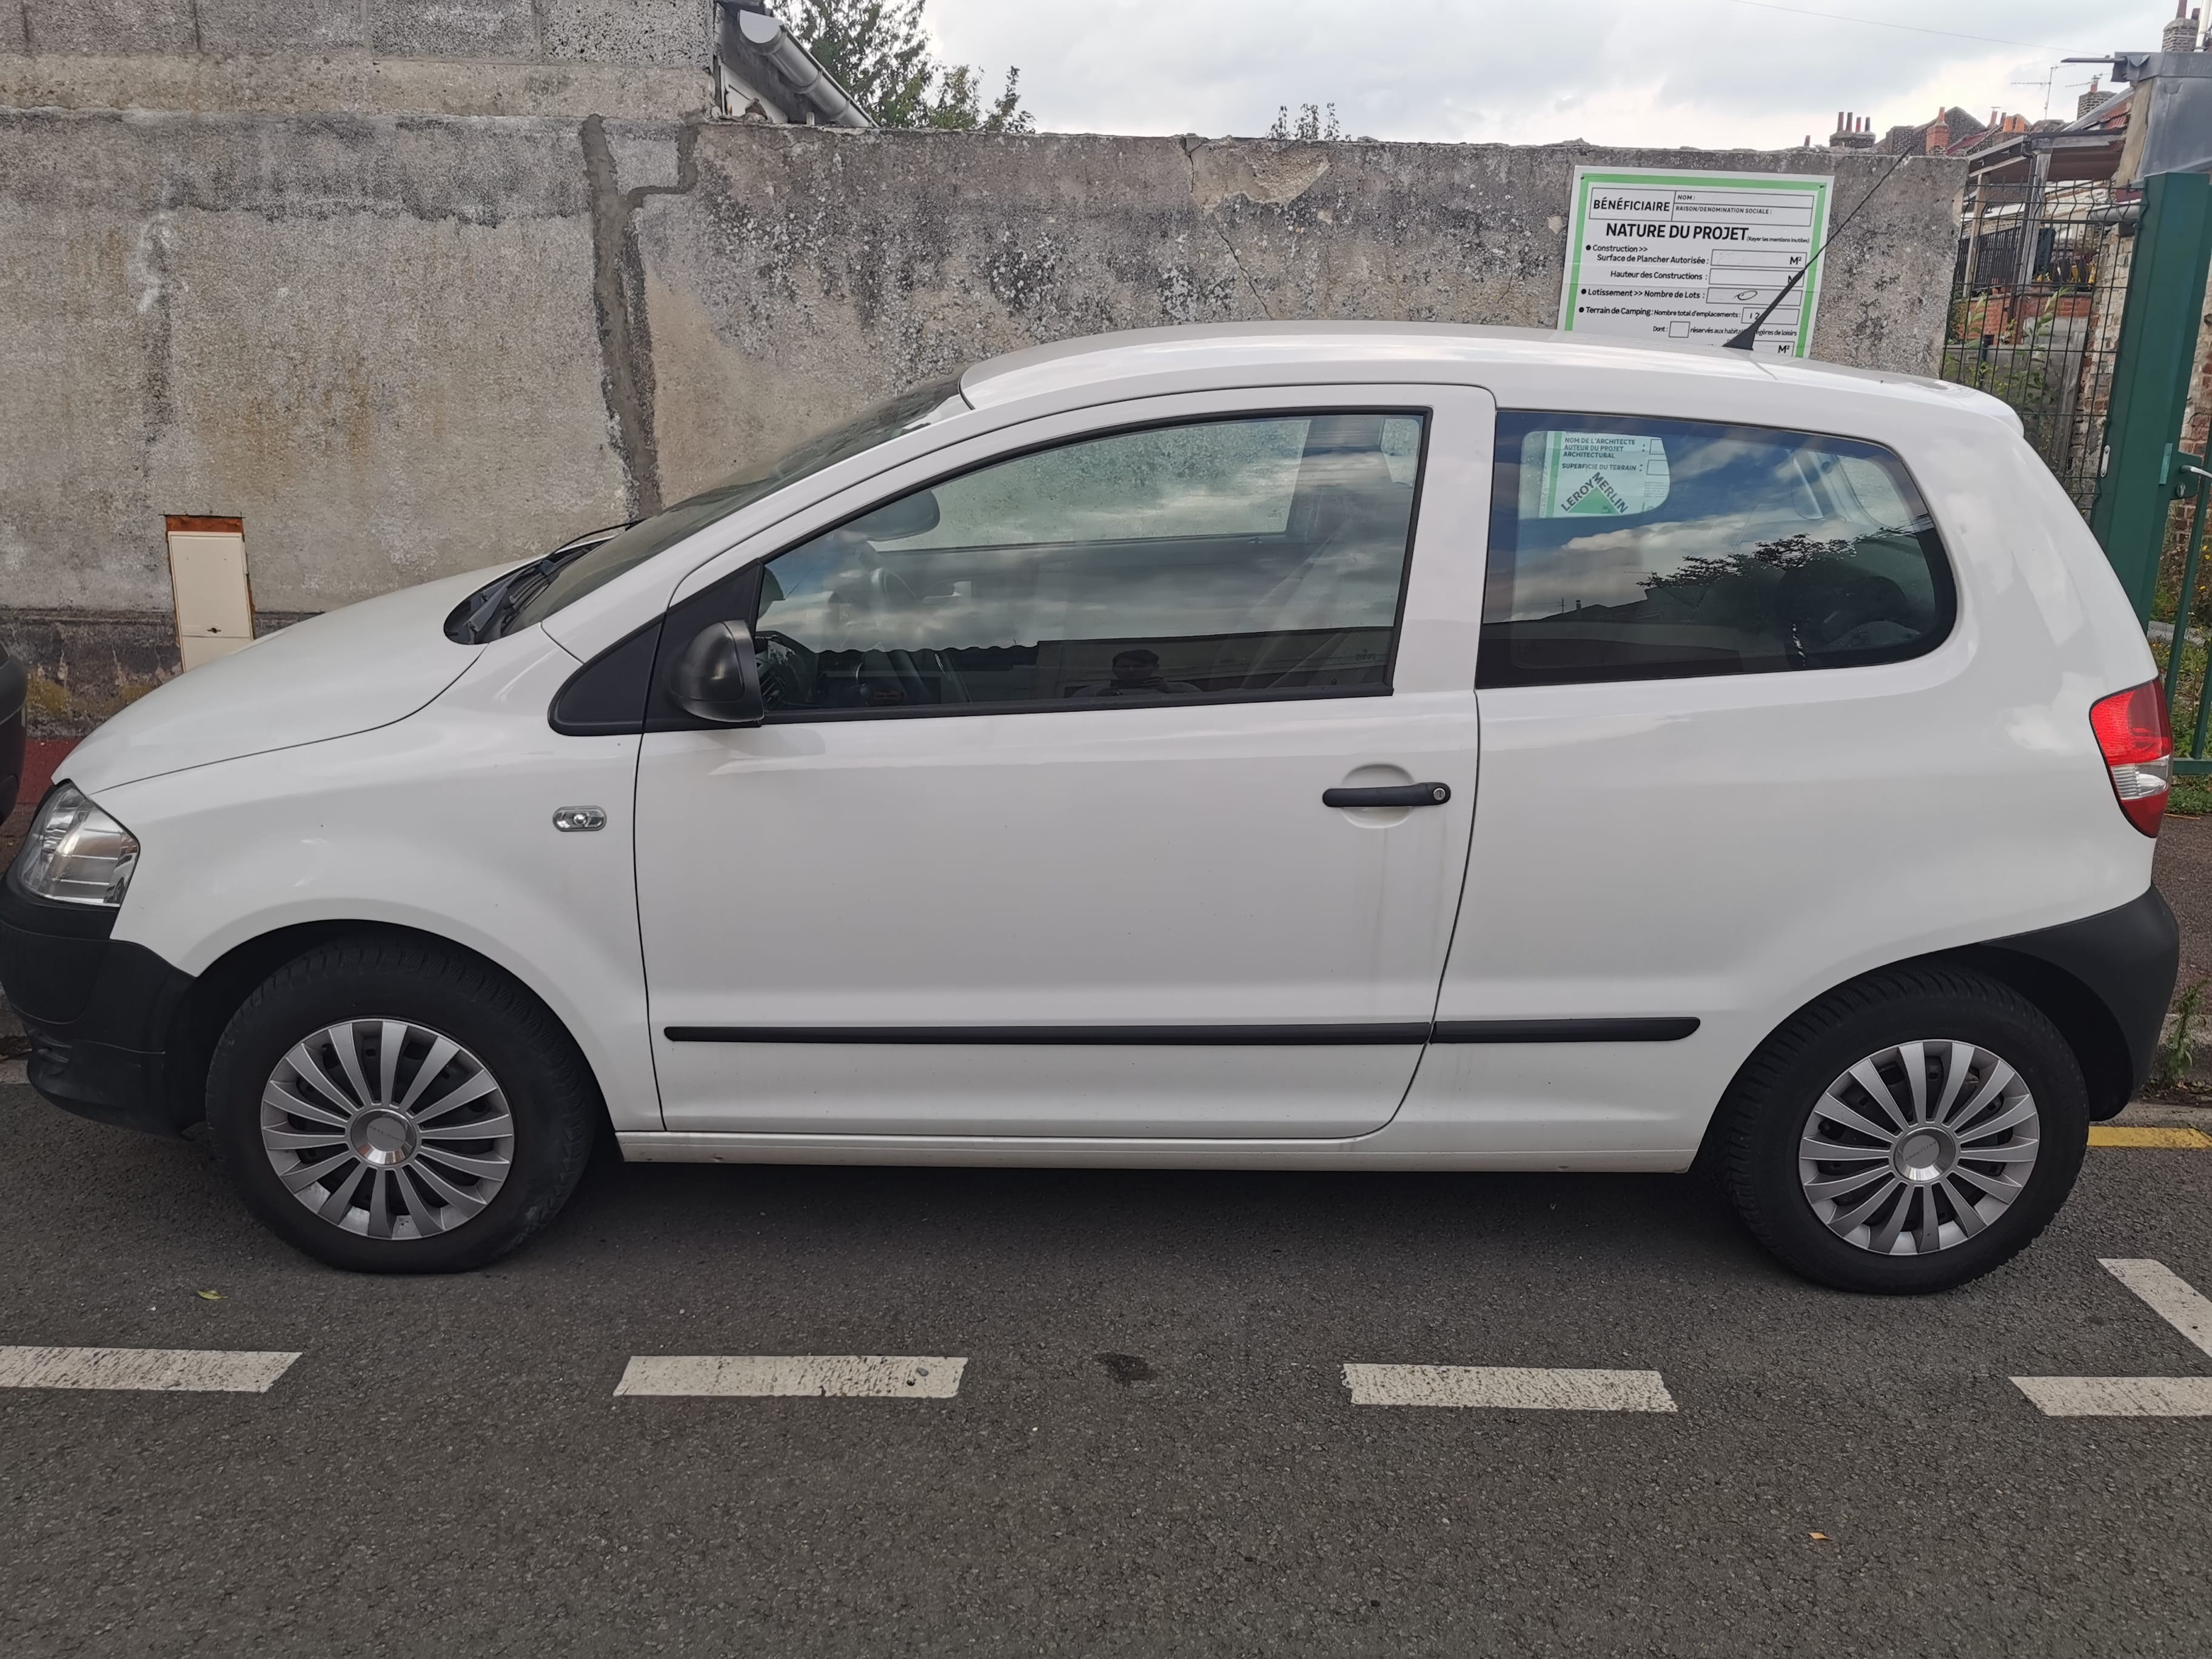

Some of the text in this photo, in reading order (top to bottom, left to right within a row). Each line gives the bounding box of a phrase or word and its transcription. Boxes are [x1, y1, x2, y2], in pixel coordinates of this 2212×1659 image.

[1593, 197, 1671, 212] BÉNÉFICIAIRE
[1606, 223, 1749, 241] NATURE DU PROJET
[1592, 244, 1638, 253] Construction
[1597, 253, 1626, 262] Surface
[1626, 254, 1635, 263] de
[1637, 255, 1670, 263] Plancher
[1670, 256, 1706, 264] Autorisée
[1654, 272, 1703, 280] Constructions
[1587, 288, 1633, 297] Lotissement
[1644, 289, 1674, 298] Nombre
[1684, 290, 1700, 298] Lots
[1561, 478, 1594, 512] LEROY
[1592, 471, 1629, 514] MERLIN
